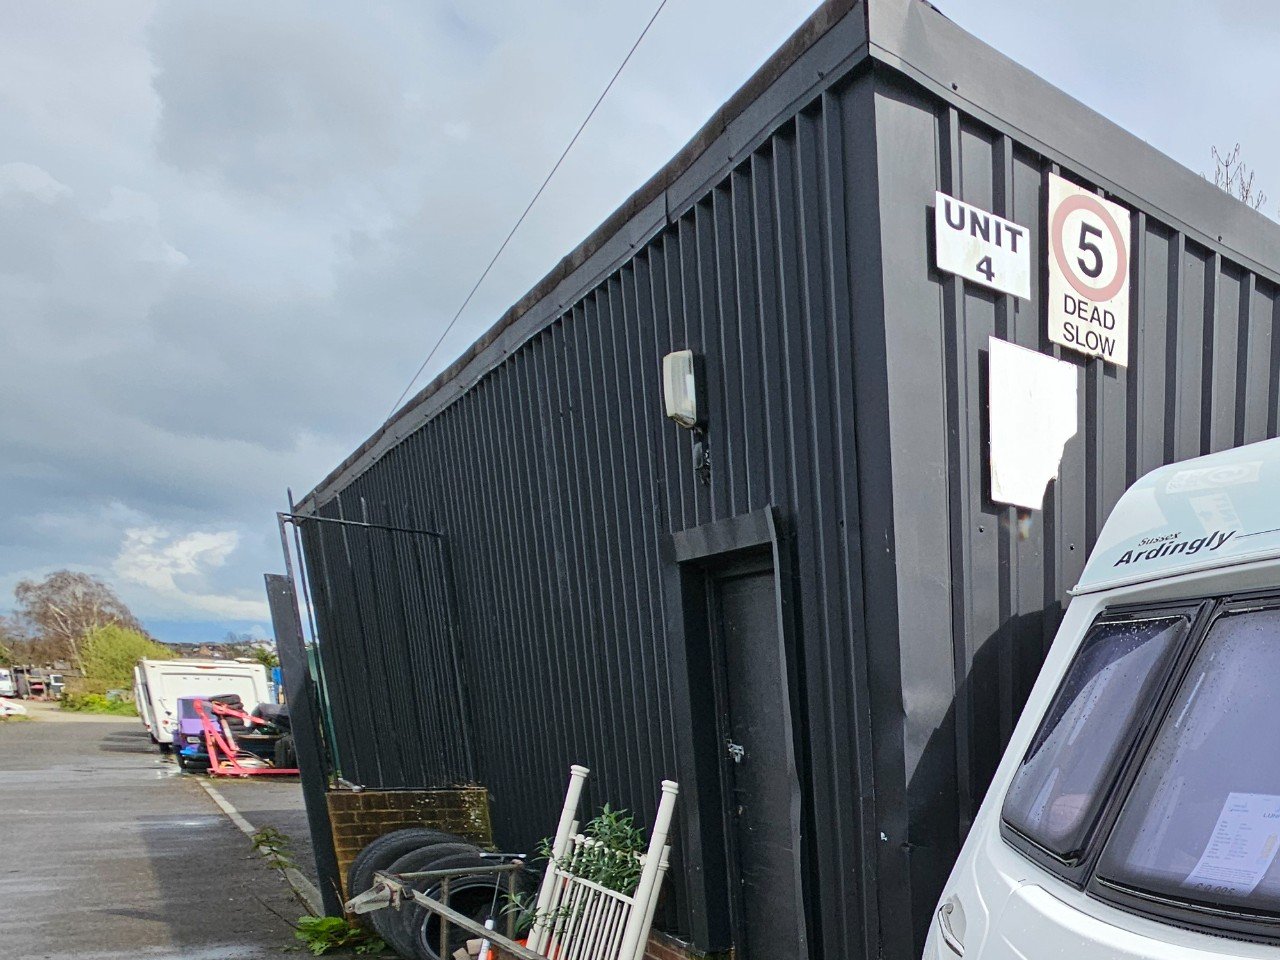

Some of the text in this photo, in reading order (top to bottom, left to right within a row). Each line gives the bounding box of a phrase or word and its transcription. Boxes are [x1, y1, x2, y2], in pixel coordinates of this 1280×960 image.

[944, 199, 1023, 253] UNIT
[1076, 220, 1104, 279] 5
[975, 255, 996, 282] 4
[1063, 293, 1116, 331] DEAD
[1062, 322, 1116, 357] SLOW
[1113, 530, 1237, 567] Ardingly
[1138, 531, 1182, 547] Sussex
